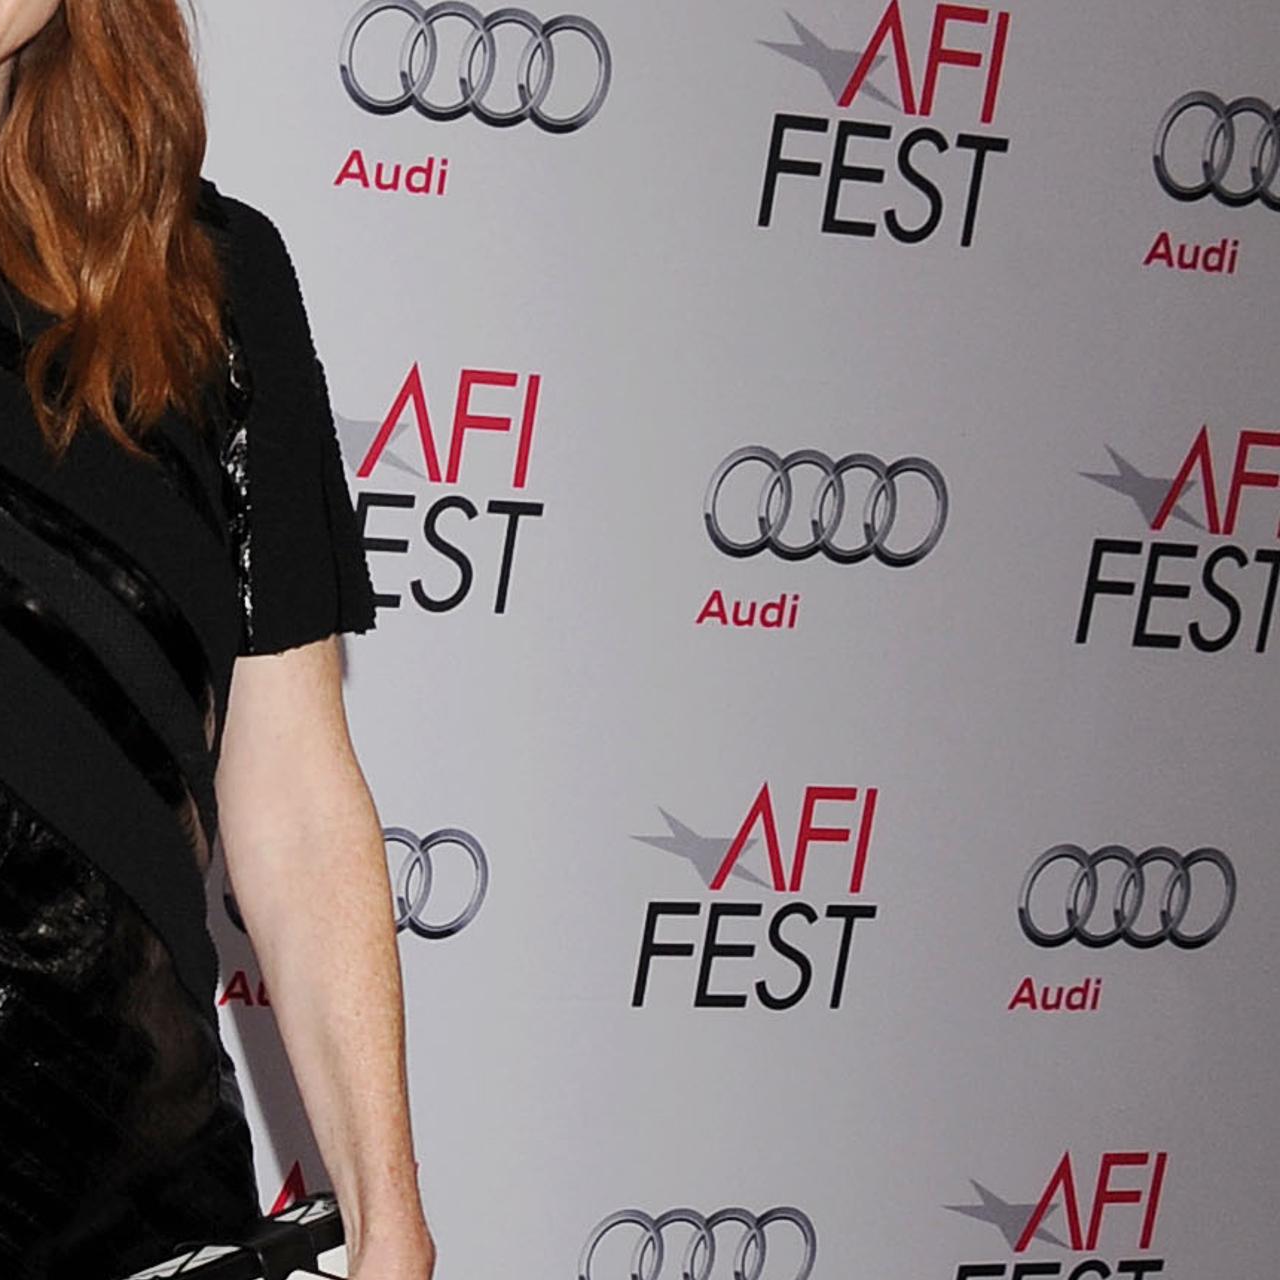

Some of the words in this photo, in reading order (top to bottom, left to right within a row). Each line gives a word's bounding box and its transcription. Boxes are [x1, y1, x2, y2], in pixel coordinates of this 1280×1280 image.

[840, 0, 1011, 124] AFI
[335, 149, 448, 196] Audi
[758, 113, 1010, 248] FEST
[1144, 231, 1239, 274] Audi
[356, 361, 542, 489] AFI
[1150, 424, 1280, 540] AF
[356, 491, 545, 614] EST
[695, 589, 799, 630] Audi
[709, 782, 878, 894] AFI
[631, 901, 878, 1011] FEST
[1008, 978, 1102, 1012] Audi
[1015, 1151, 1168, 1253] AFI
